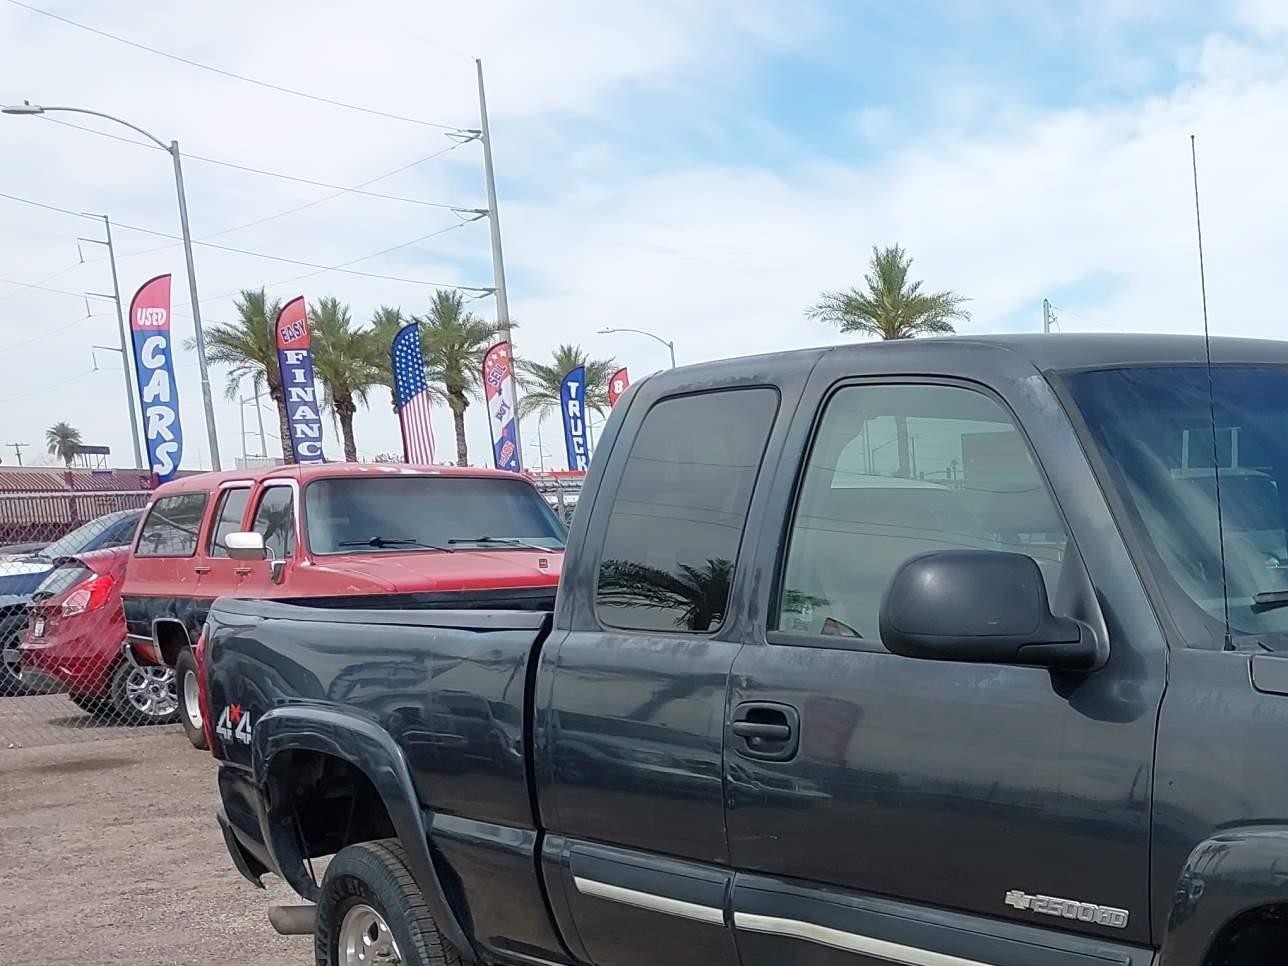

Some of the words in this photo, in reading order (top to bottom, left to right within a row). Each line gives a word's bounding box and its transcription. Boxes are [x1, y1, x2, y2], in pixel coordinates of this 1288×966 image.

[136, 307, 167, 326] USED
[281, 320, 307, 344] EASY
[141, 335, 178, 476] CARS
[284, 350, 322, 464] FINANC
[567, 382, 588, 472] TRUCK
